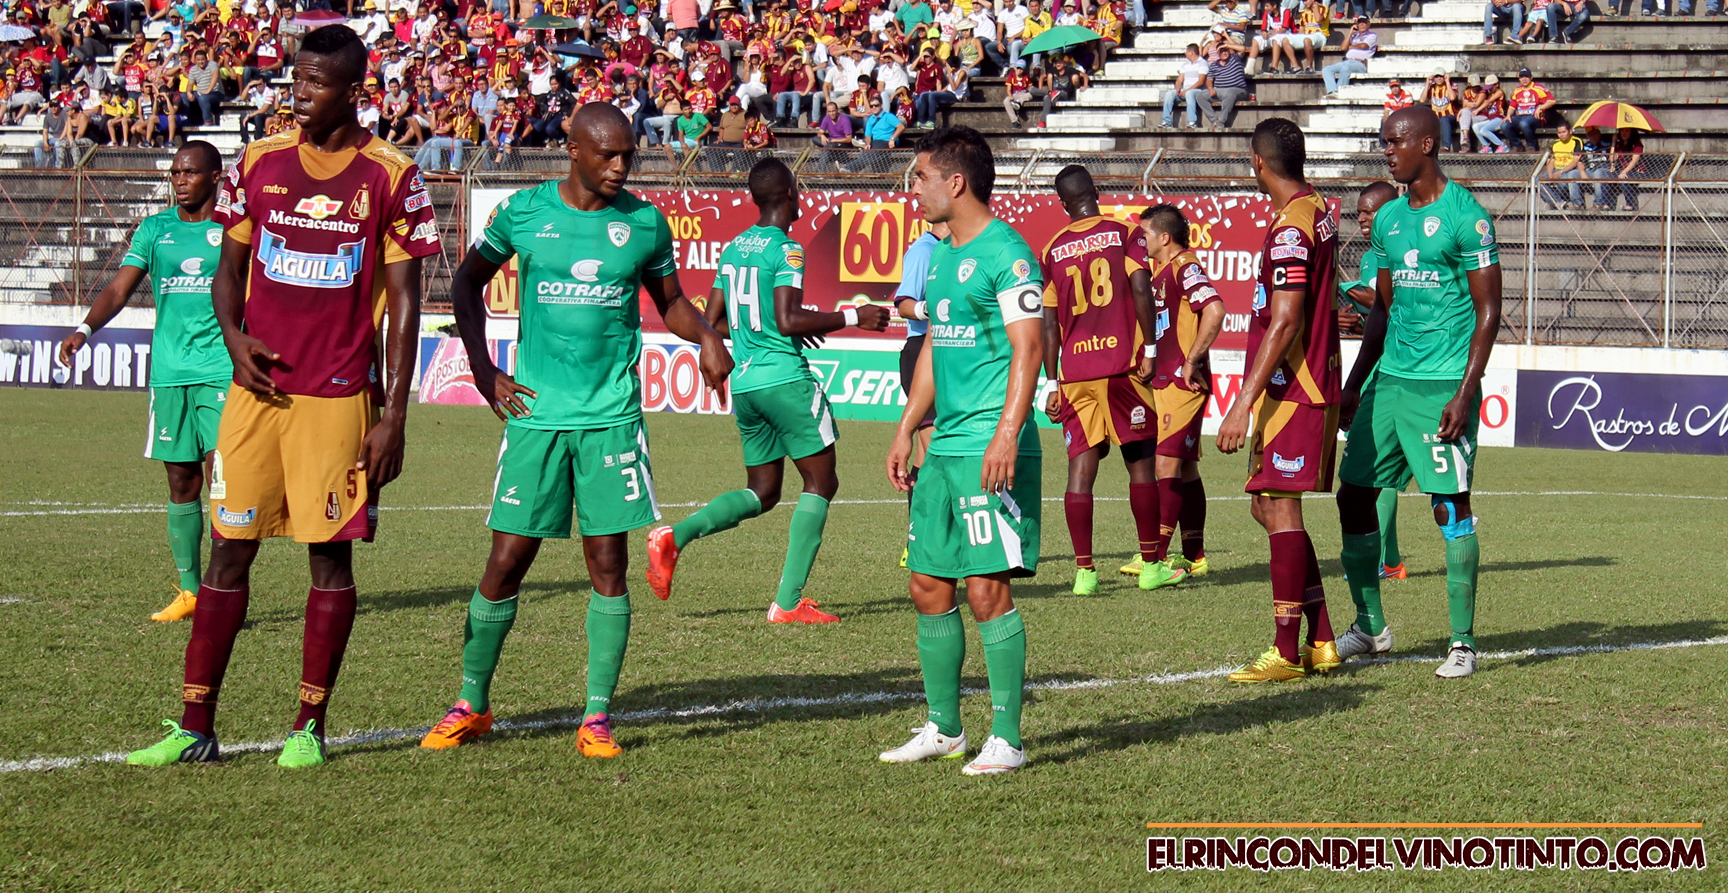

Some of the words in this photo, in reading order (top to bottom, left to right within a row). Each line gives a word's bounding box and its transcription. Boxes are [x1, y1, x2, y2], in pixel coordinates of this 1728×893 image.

[262, 184, 288, 194] mitre
[408, 193, 431, 209] BOY
[268, 209, 360, 234] Mercacentro
[844, 209, 899, 277] 60
[1051, 240, 1085, 261] TAPA
[270, 254, 347, 281] AGUILA
[1274, 266, 1287, 286] C
[537, 281, 624, 299] COTRAFA
[1065, 257, 1114, 316] 18
[1018, 289, 1041, 314] C
[1073, 335, 1118, 354] mitre
[1163, 413, 1172, 431] 9
[1548, 375, 1655, 452] Rastros
[1659, 403, 1681, 436] de
[1276, 461, 1300, 471] AGUILA
[1432, 446, 1448, 474] 5
[346, 469, 357, 499] 5
[620, 466, 640, 502] 3
[221, 514, 250, 524] AGUILA
[962, 509, 993, 547] 10
